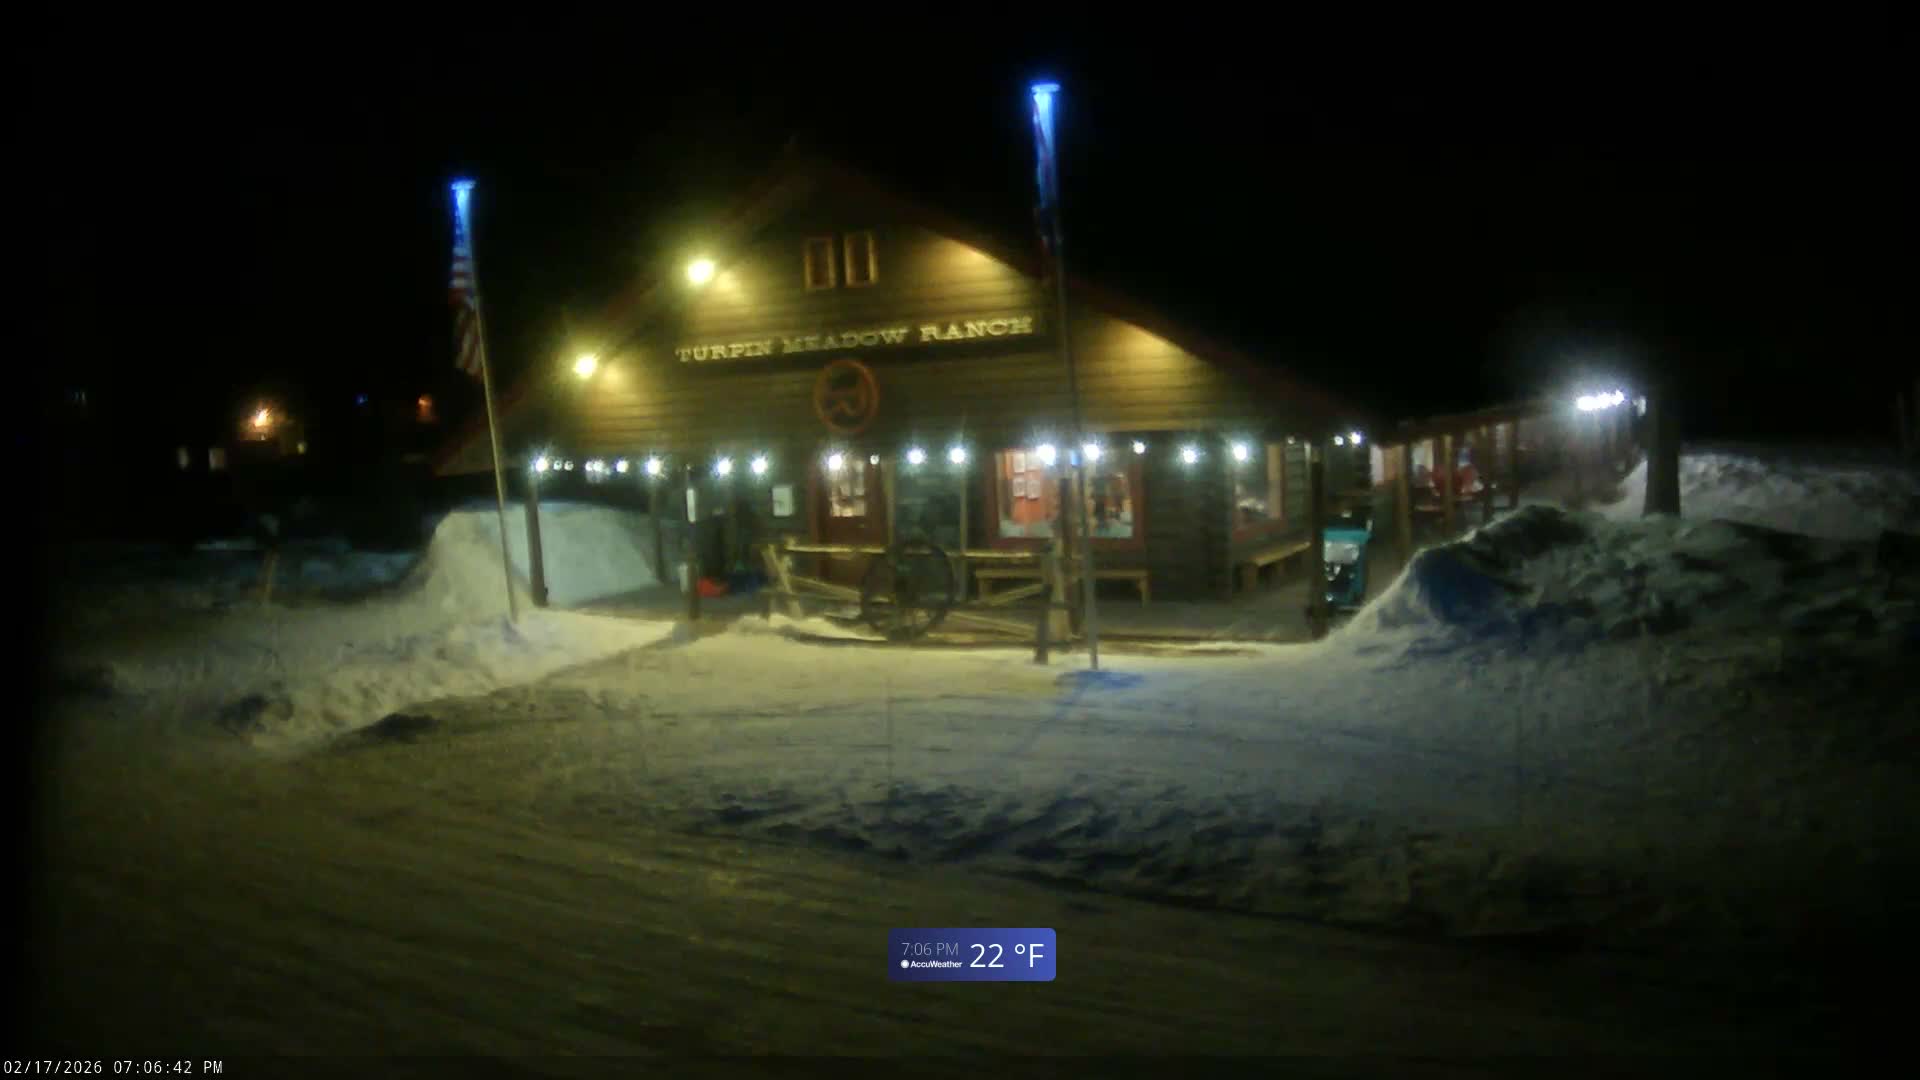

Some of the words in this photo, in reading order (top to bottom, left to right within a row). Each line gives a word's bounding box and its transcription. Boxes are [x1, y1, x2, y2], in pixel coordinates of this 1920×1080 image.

[675, 341, 771, 363] TURPIN
[783, 327, 910, 354] MEADOW
[920, 316, 1034, 342] RANCH
